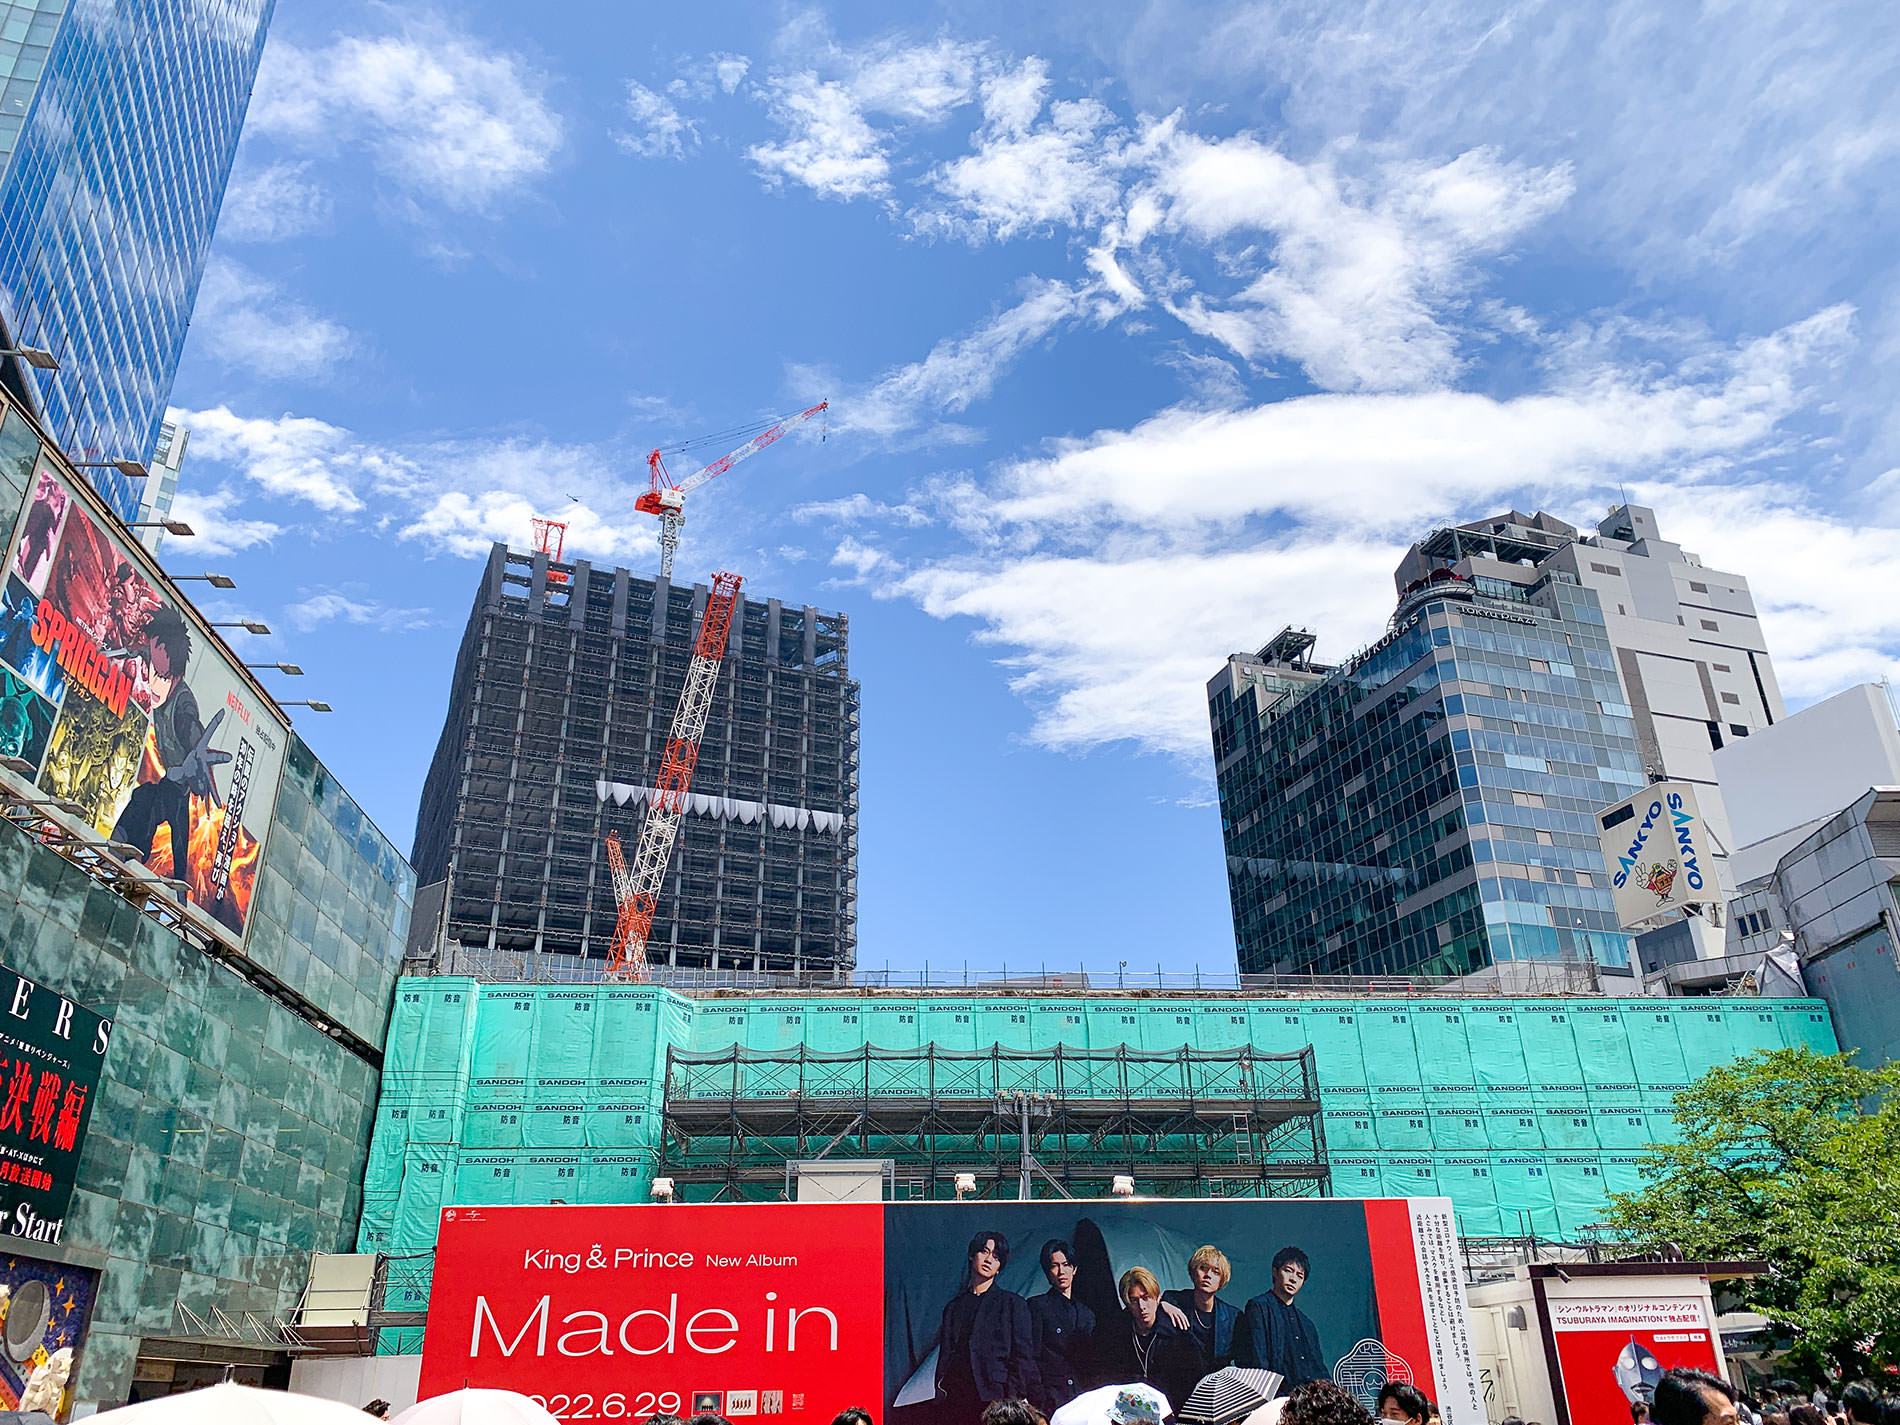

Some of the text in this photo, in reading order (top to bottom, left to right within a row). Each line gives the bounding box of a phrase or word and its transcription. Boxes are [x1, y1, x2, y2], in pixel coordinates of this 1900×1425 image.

[1460, 606, 1539, 625] TOKYU PLAZA
[1355, 613, 1419, 668] FUKURAS
[31, 599, 131, 720] SPRIGGAN
[61, 671, 92, 701] スプリガン
[226, 690, 250, 726] NETFLIX
[1613, 801, 1662, 889] SANKYO
[1666, 793, 1703, 890] SANKYO
[667, 997, 693, 1011] SANDO
[524, 1247, 798, 1274] King & Prince New Album
[470, 1291, 838, 1357] Made in
[1556, 1316, 1606, 1324] TSUBURAYA
